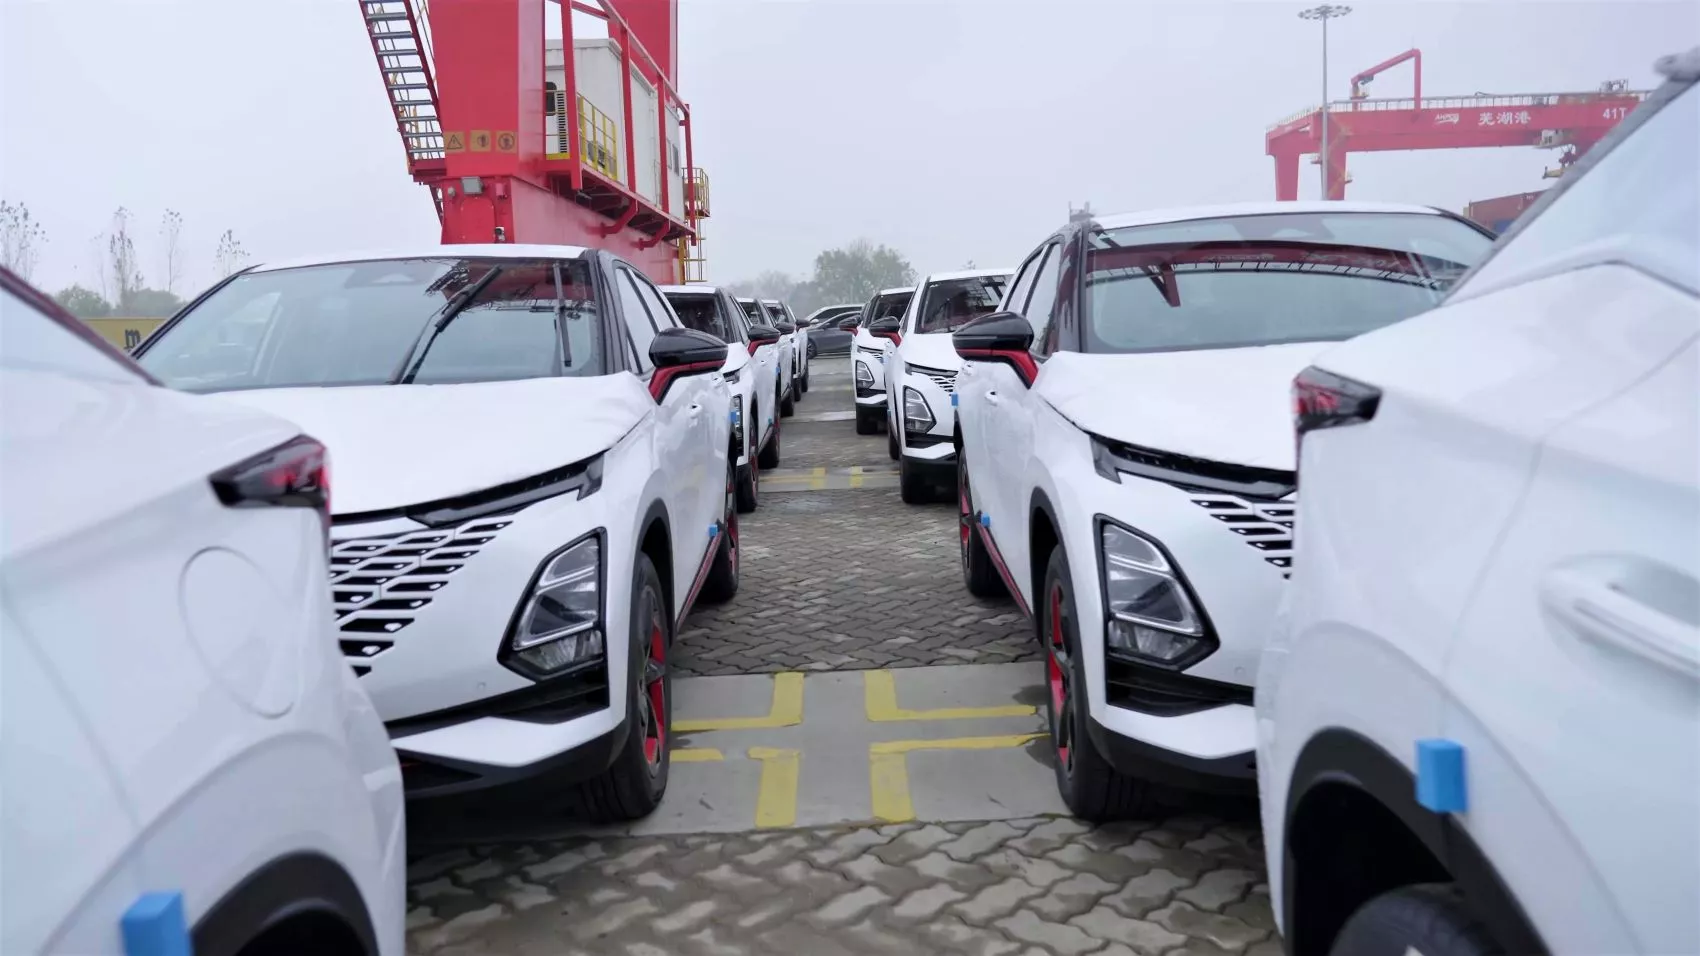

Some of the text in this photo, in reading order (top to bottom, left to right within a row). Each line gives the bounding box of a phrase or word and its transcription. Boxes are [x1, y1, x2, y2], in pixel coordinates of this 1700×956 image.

[1478, 110, 1531, 125] 芜湖港
[1602, 107, 1627, 120] 41T
